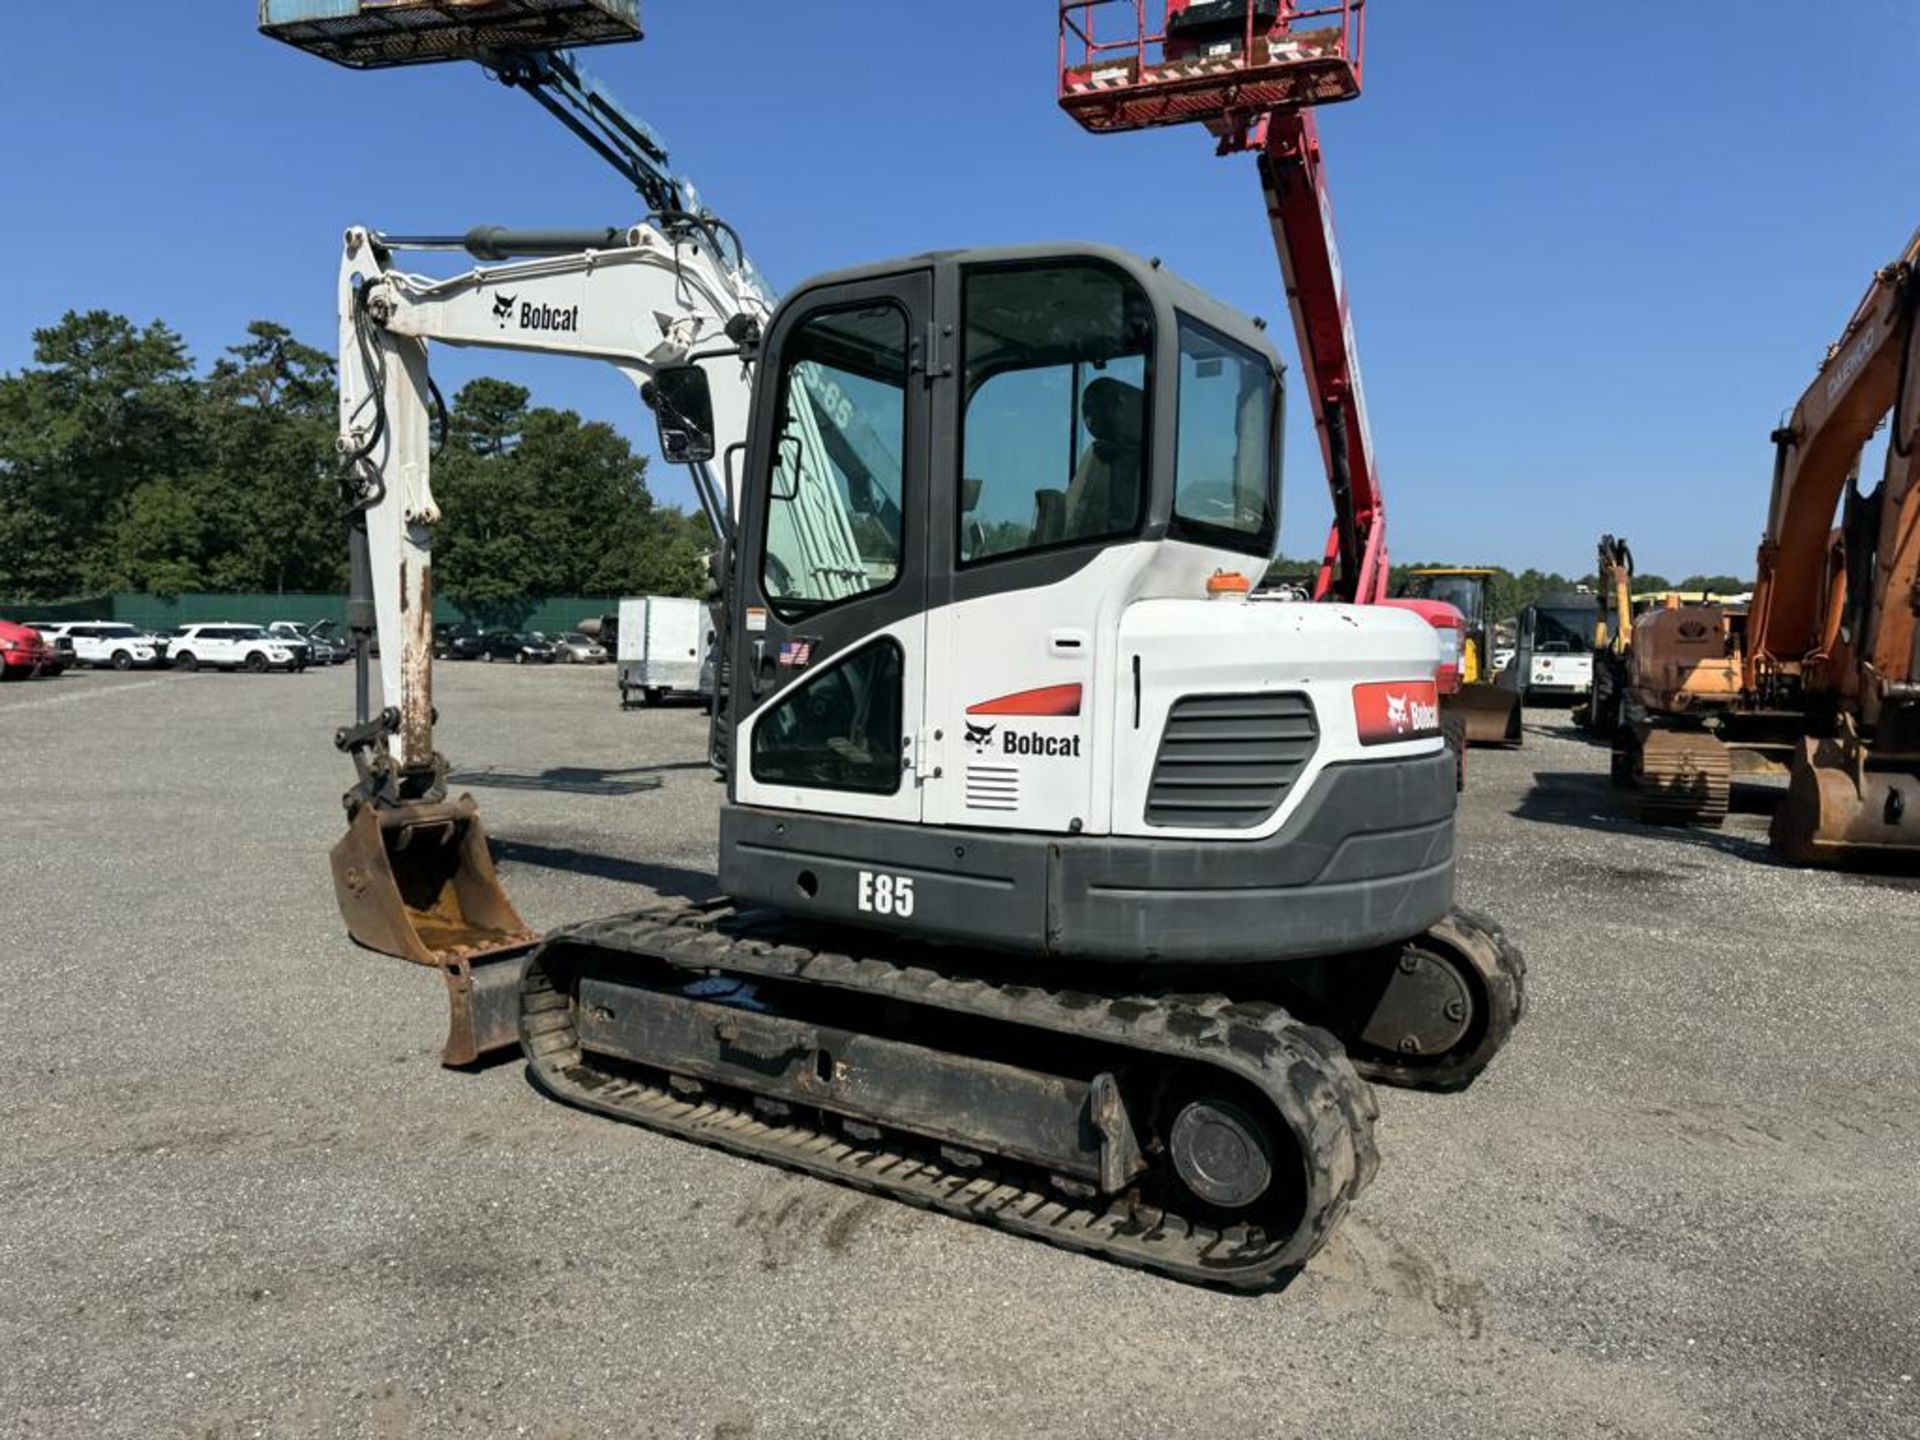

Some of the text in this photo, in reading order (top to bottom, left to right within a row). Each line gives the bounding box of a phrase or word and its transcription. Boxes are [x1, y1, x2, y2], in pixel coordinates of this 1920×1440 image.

[520, 301, 578, 332] Bobcat
[1003, 730, 1081, 757] Bobcat
[858, 871, 914, 918] E85
